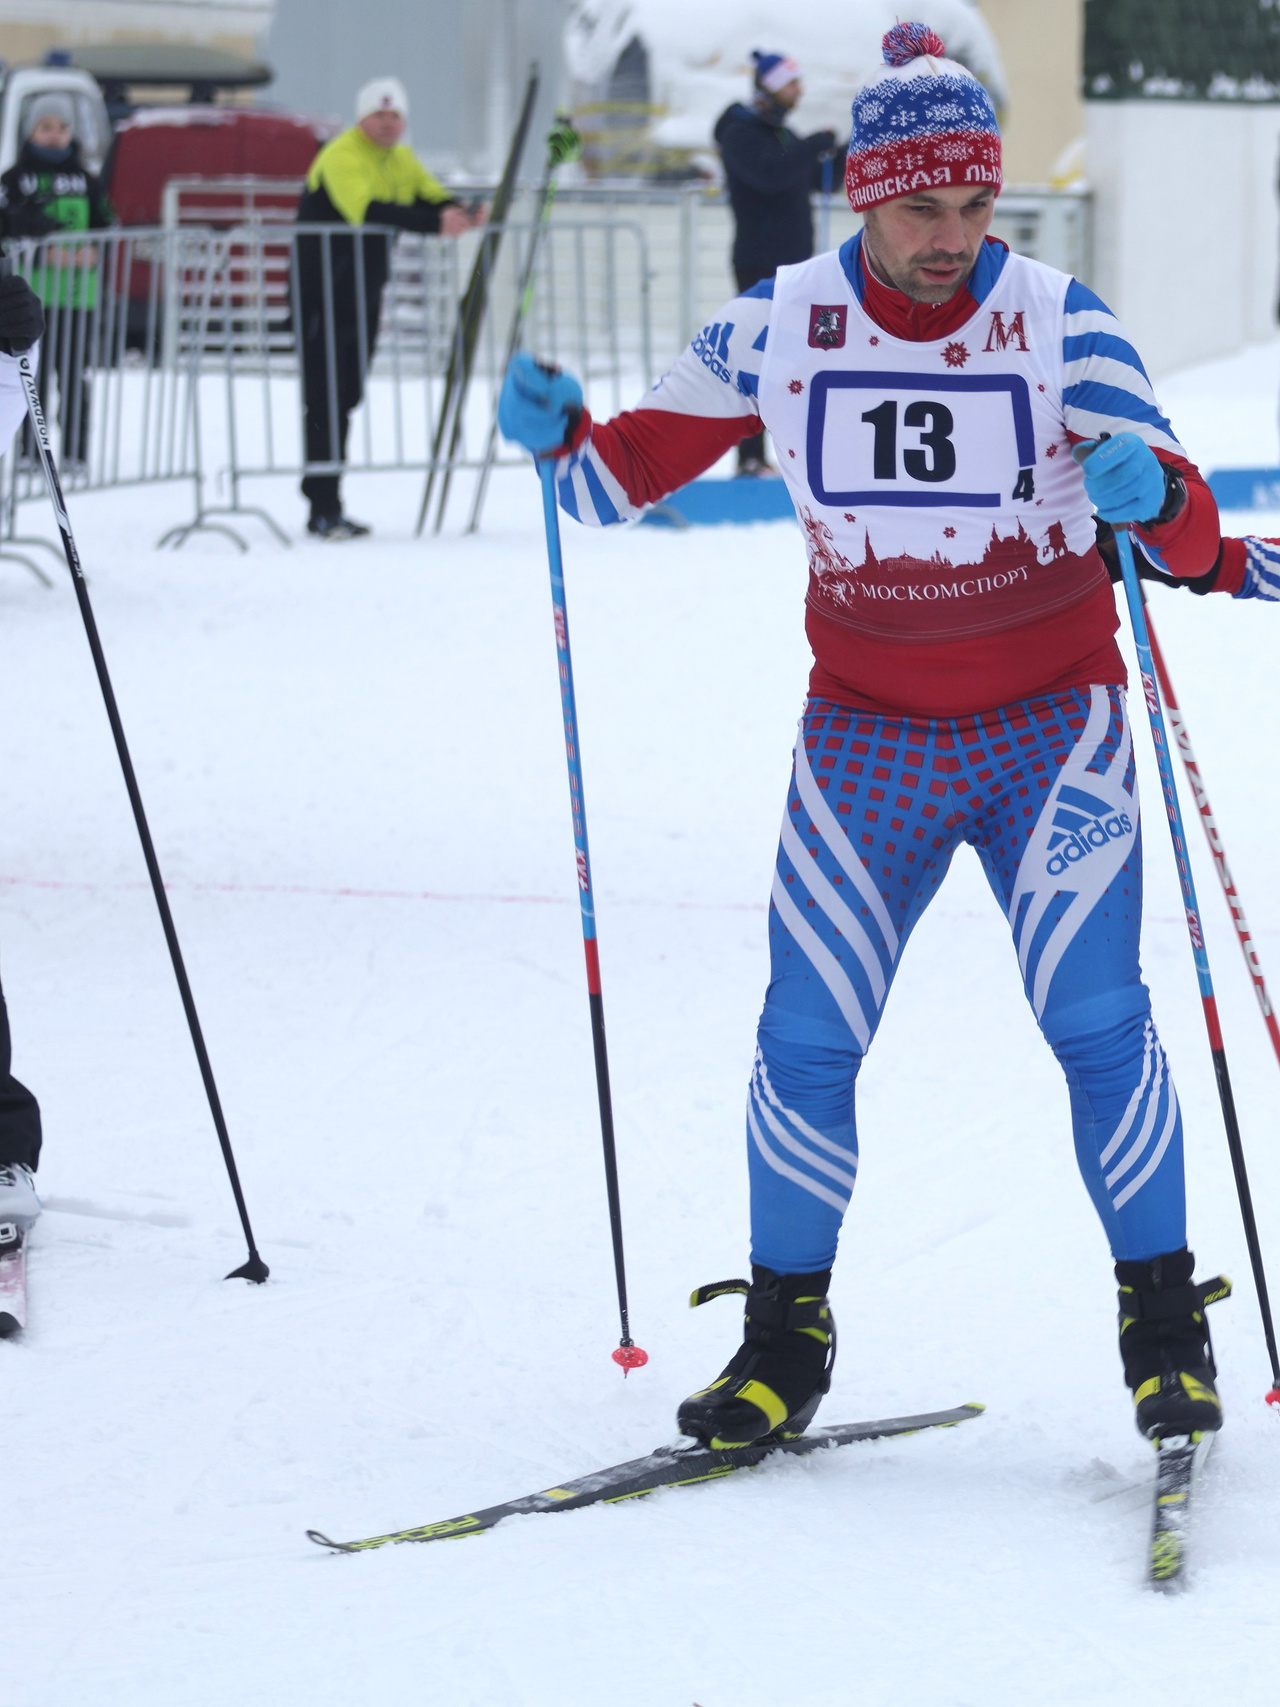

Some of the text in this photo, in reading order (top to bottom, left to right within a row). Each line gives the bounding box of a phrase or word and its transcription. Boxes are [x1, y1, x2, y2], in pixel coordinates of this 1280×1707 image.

[850, 166, 951, 208] ЯНОВСКАЯ
[26, 380, 50, 447] NORDWAY
[861, 400, 956, 483] 13
[1012, 468, 1036, 503] 4
[861, 565, 1029, 601] МОСКОМСПОРТ
[1046, 812, 1133, 876] adidas
